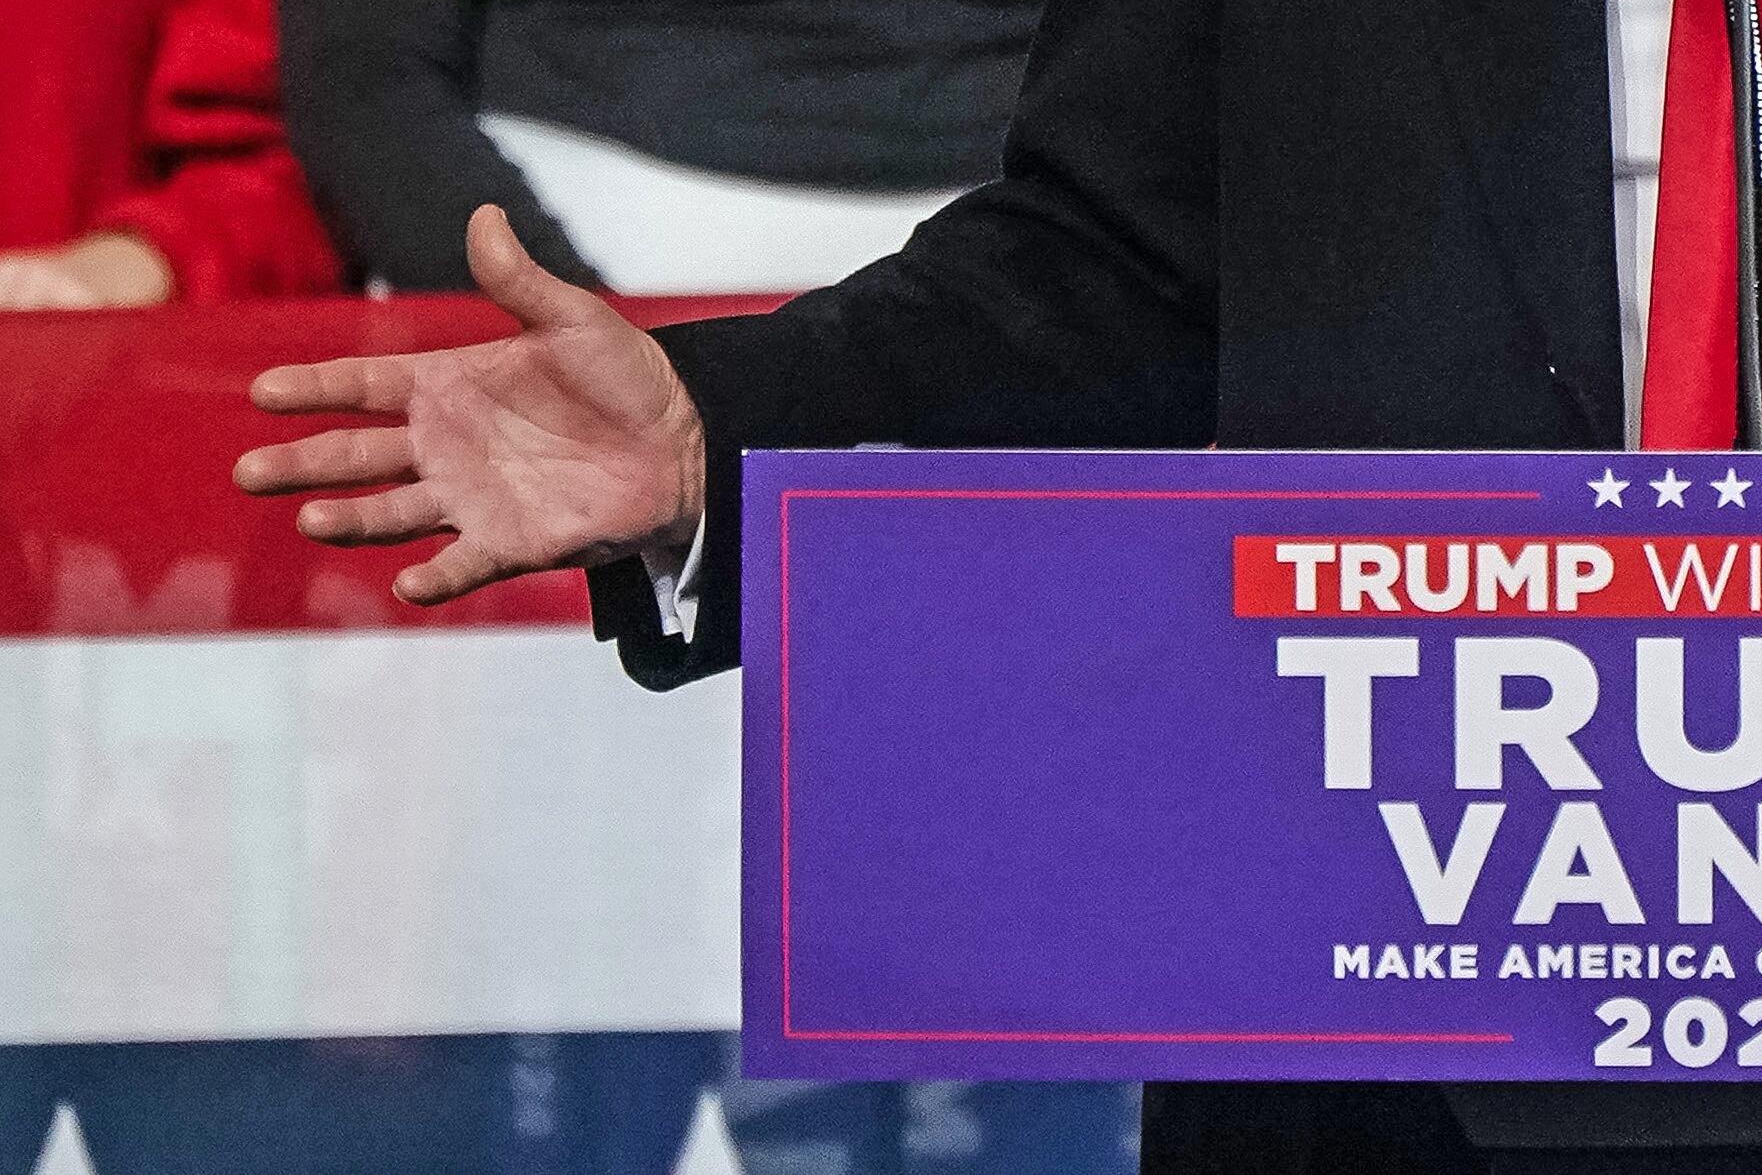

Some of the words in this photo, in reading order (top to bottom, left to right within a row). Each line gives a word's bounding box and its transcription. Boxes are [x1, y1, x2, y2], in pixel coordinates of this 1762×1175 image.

[1276, 542, 1614, 613] TRUMP
[1333, 944, 1479, 979] MAKE
[1498, 943, 1736, 980] AMERICA
